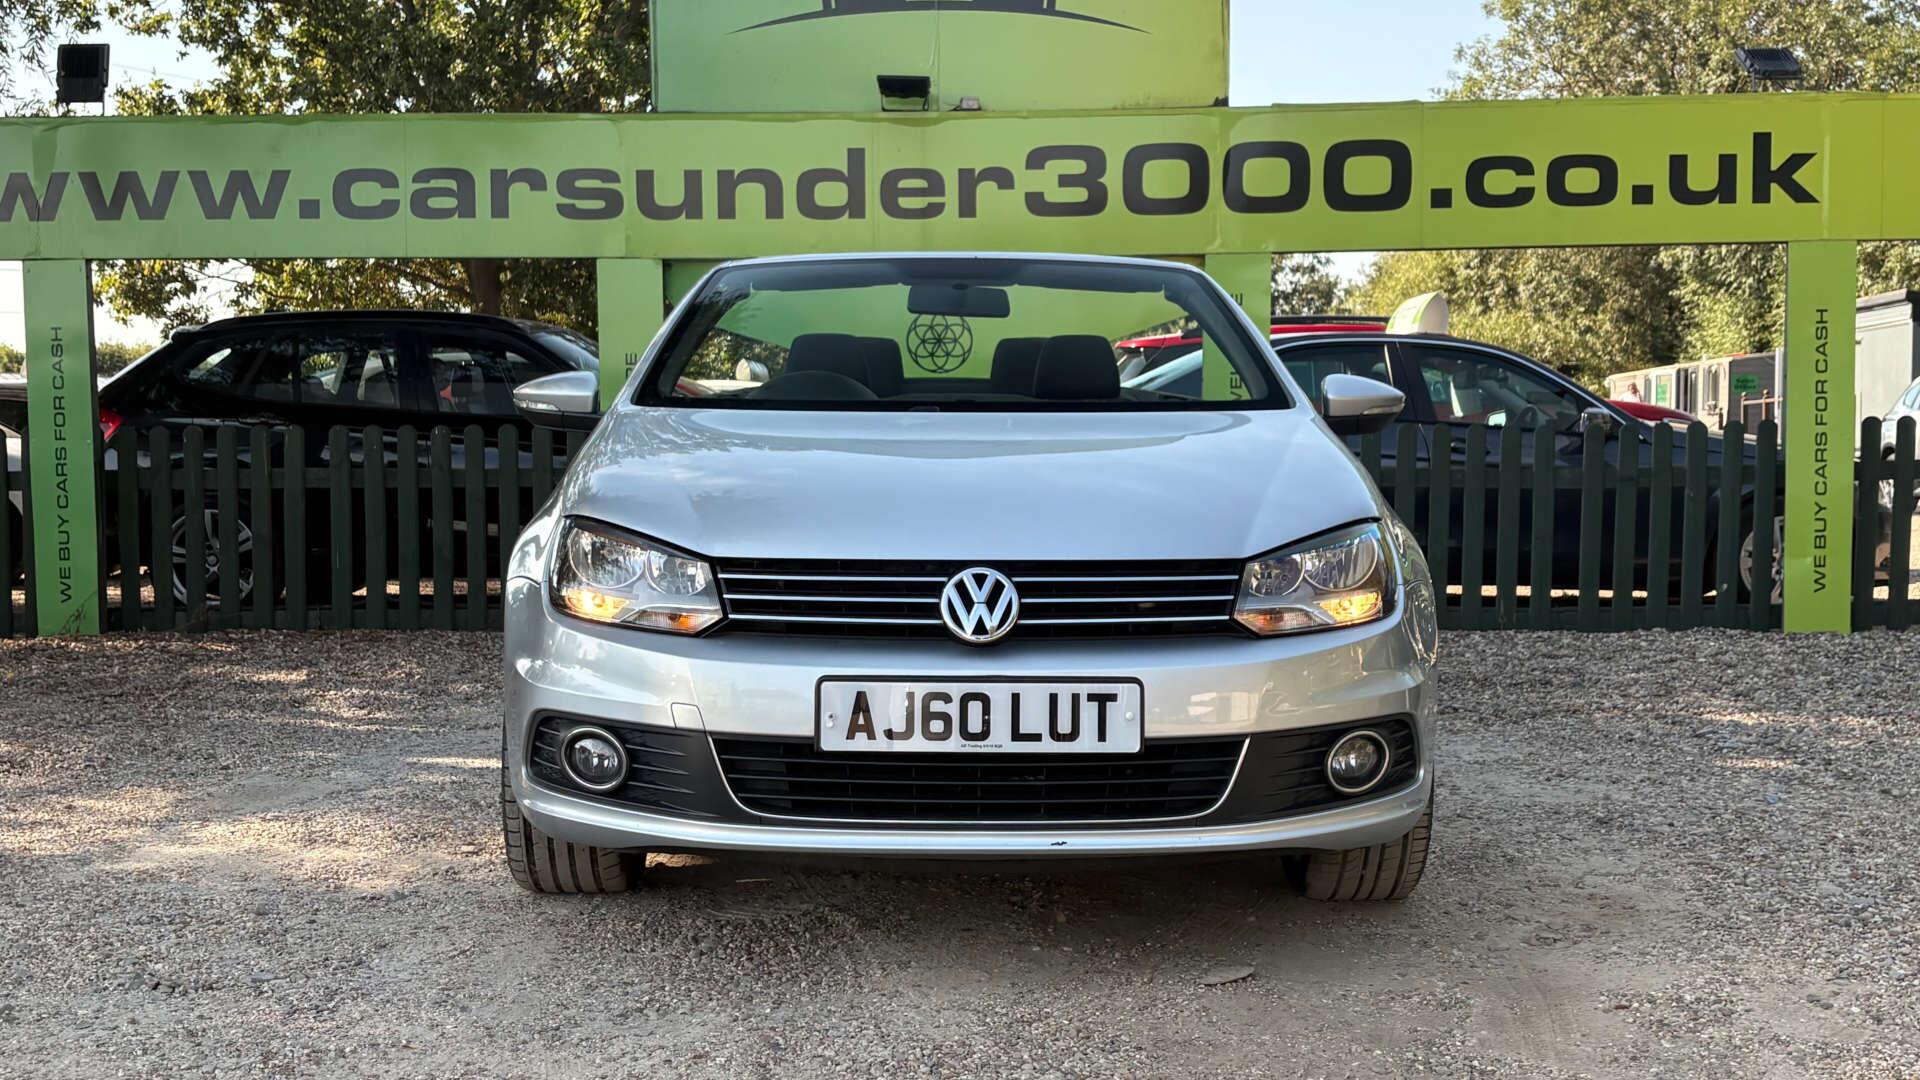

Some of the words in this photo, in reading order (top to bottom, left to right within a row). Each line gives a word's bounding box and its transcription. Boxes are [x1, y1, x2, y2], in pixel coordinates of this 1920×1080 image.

[0, 132, 1820, 222] www.carsunder3000.co.uk
[51, 326, 65, 390] CASH
[1815, 308, 1829, 373] CASH
[53, 395, 66, 441] FOR
[1815, 379, 1828, 426] FOR
[55, 446, 69, 509] CARS
[1814, 432, 1828, 495] CARS
[57, 514, 70, 561] BUY
[1814, 501, 1827, 549] BUY
[60, 567, 72, 603] WE
[1813, 555, 1826, 593] WE
[846, 690, 992, 742] AJ60
[1010, 692, 1119, 743] LUT
